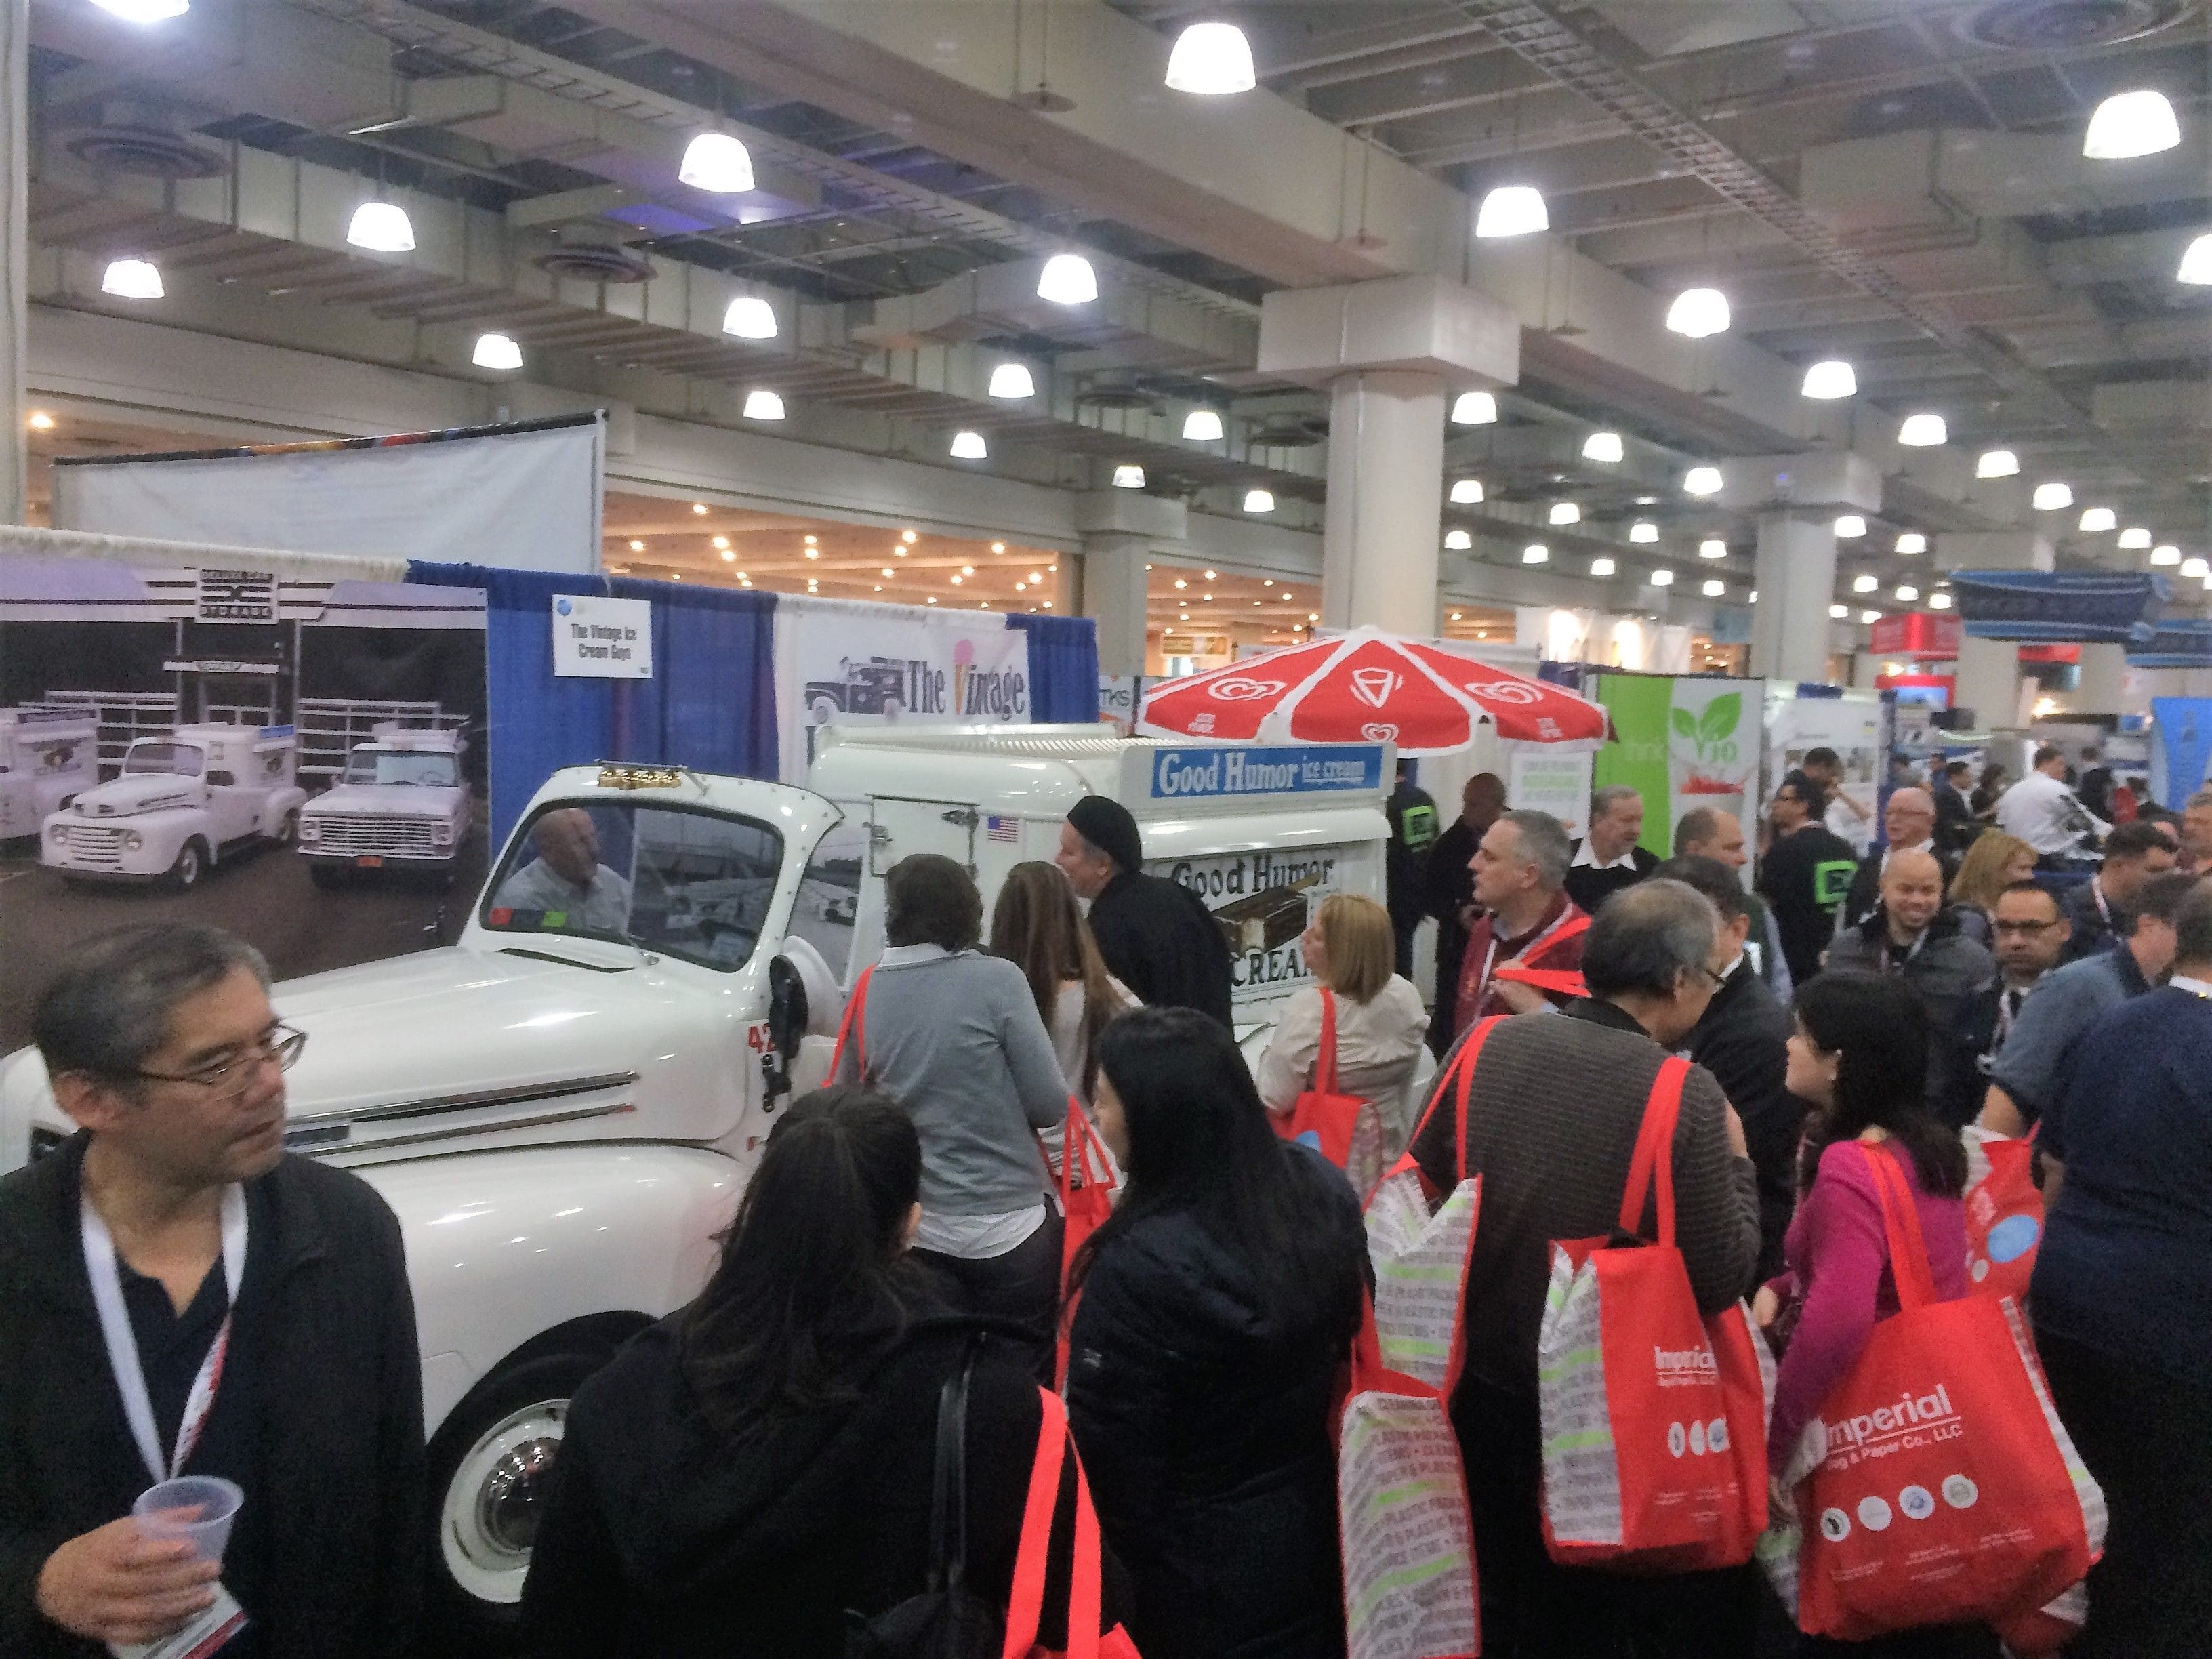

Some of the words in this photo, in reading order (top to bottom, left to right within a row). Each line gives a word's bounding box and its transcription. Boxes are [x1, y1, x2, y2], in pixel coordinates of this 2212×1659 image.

[571, 623, 587, 638] The
[590, 624, 622, 642] Vintage
[579, 643, 608, 658] Cream
[611, 644, 631, 661] Guys
[908, 660, 945, 714] The
[1159, 753, 1220, 794] Good
[1224, 752, 1299, 792] Humor
[1302, 754, 1320, 779] ice
[1323, 760, 1366, 779] cream
[1172, 858, 1246, 898] Good
[1252, 855, 1336, 893] Humor
[1230, 949, 1308, 987] CREA
[1827, 1383, 1954, 1447] mperial
[1861, 1442, 1899, 1459] Paper
[1932, 1424, 1963, 1441] LLC
